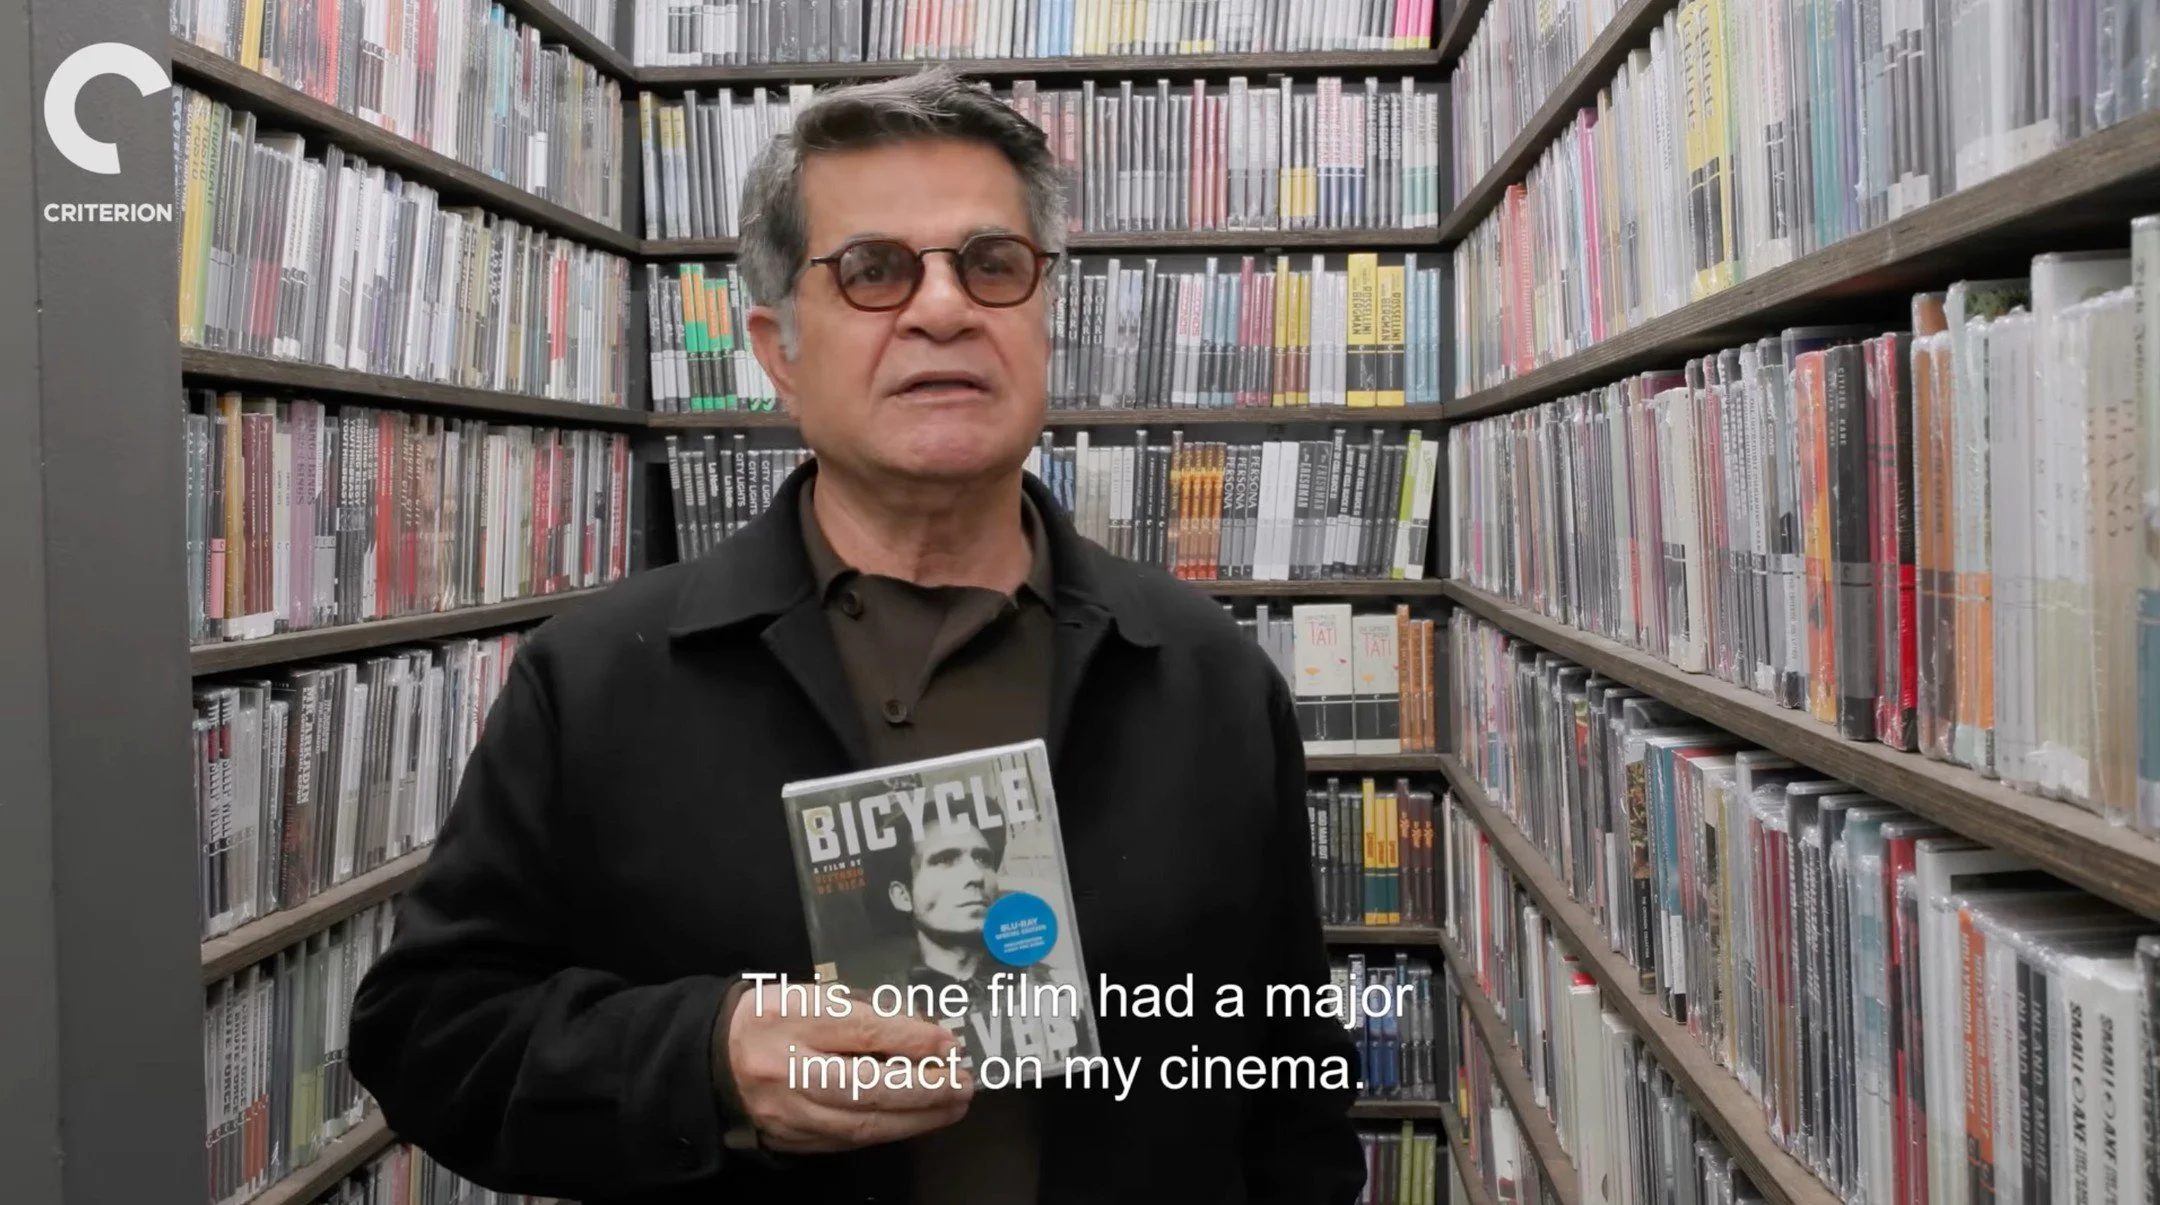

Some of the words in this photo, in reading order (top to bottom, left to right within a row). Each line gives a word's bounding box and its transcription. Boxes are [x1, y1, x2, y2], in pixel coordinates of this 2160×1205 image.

[736, 452, 745, 474] CITY
[748, 461, 757, 483] CITY
[762, 460, 770, 482] CITY
[1224, 456, 1236, 509] PERSONA
[1235, 457, 1247, 510] PERSONA
[1248, 456, 1260, 508] PERSONA
[1297, 462, 1312, 508] FRESHMAN
[737, 476, 746, 507] LIGHTS
[749, 485, 758, 515] LIGHTS
[1314, 464, 1327, 510] FRESHMAN
[1308, 622, 1337, 647] TATI
[1361, 632, 1392, 657] TATI
[301, 722, 313, 804] ARKADIN
[802, 767, 1036, 862] BICYCLE
[823, 862, 846, 873] FILM
[2031, 1000, 2044, 1086] INLAND
[2020, 1083, 2032, 1170] EMPIRE
[2033, 1095, 2047, 1185] EMPIRE
